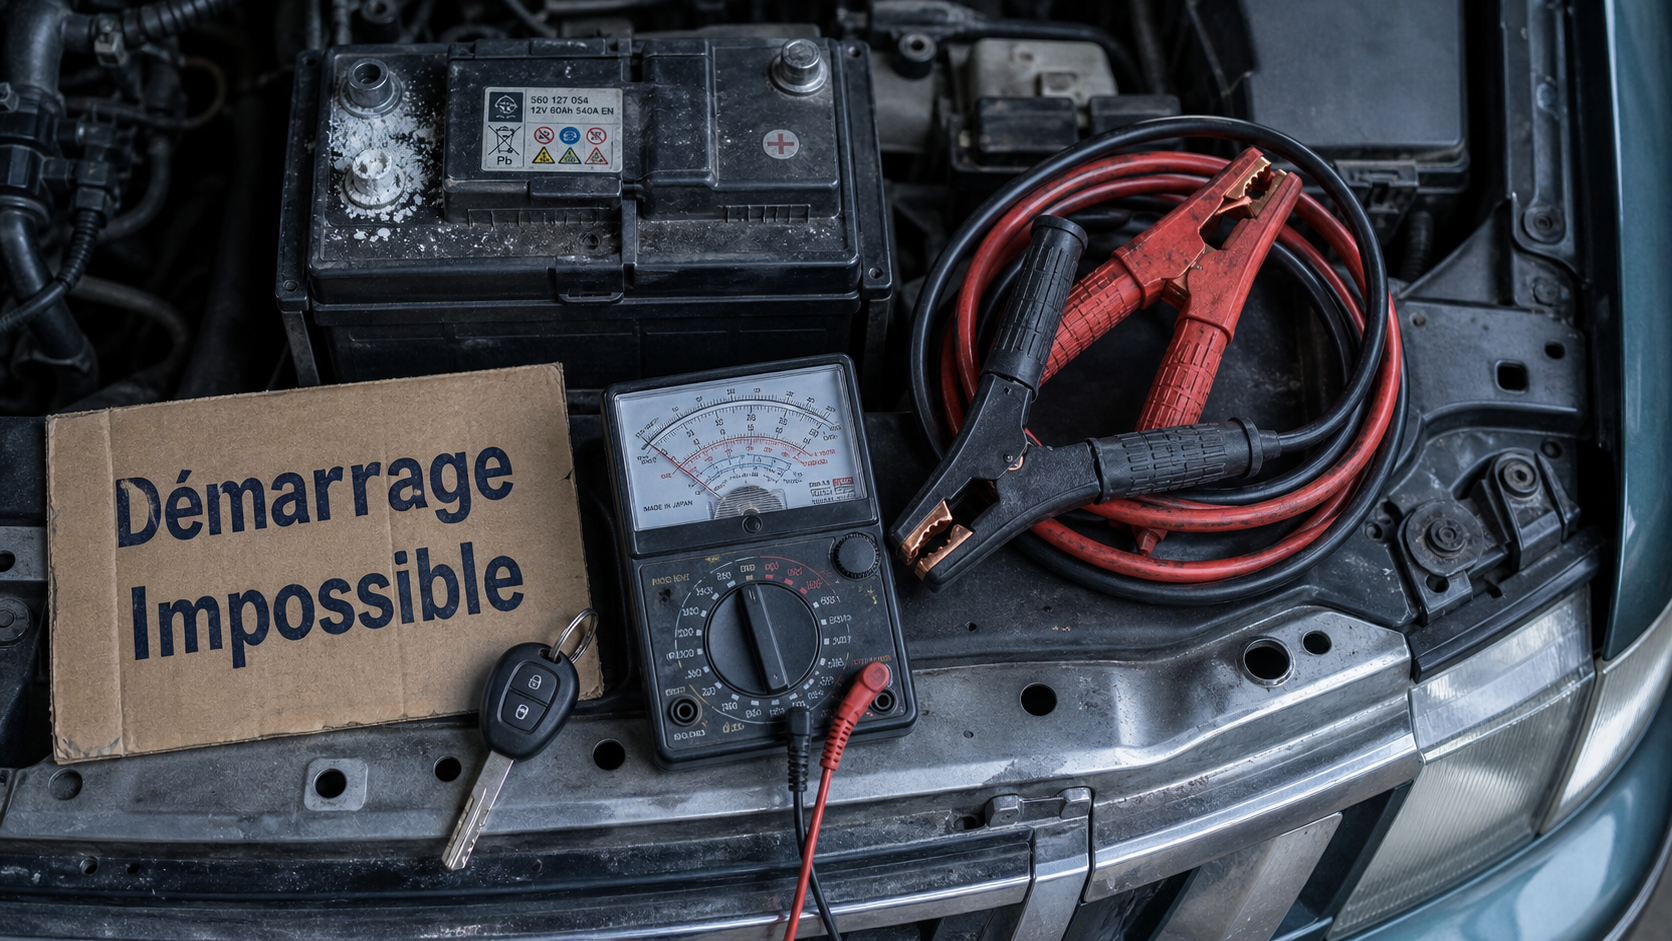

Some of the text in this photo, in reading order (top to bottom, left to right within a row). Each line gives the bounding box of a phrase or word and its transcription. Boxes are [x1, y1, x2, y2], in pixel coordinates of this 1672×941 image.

[551, 96, 568, 104] 127
[530, 106, 548, 114] 12V
[601, 107, 614, 115] EN
[496, 156, 513, 165] Pb
[115, 445, 514, 548] Démarrage
[643, 503, 663, 512] MADE
[672, 500, 693, 509] JAPAN
[131, 541, 525, 669] Impossible
